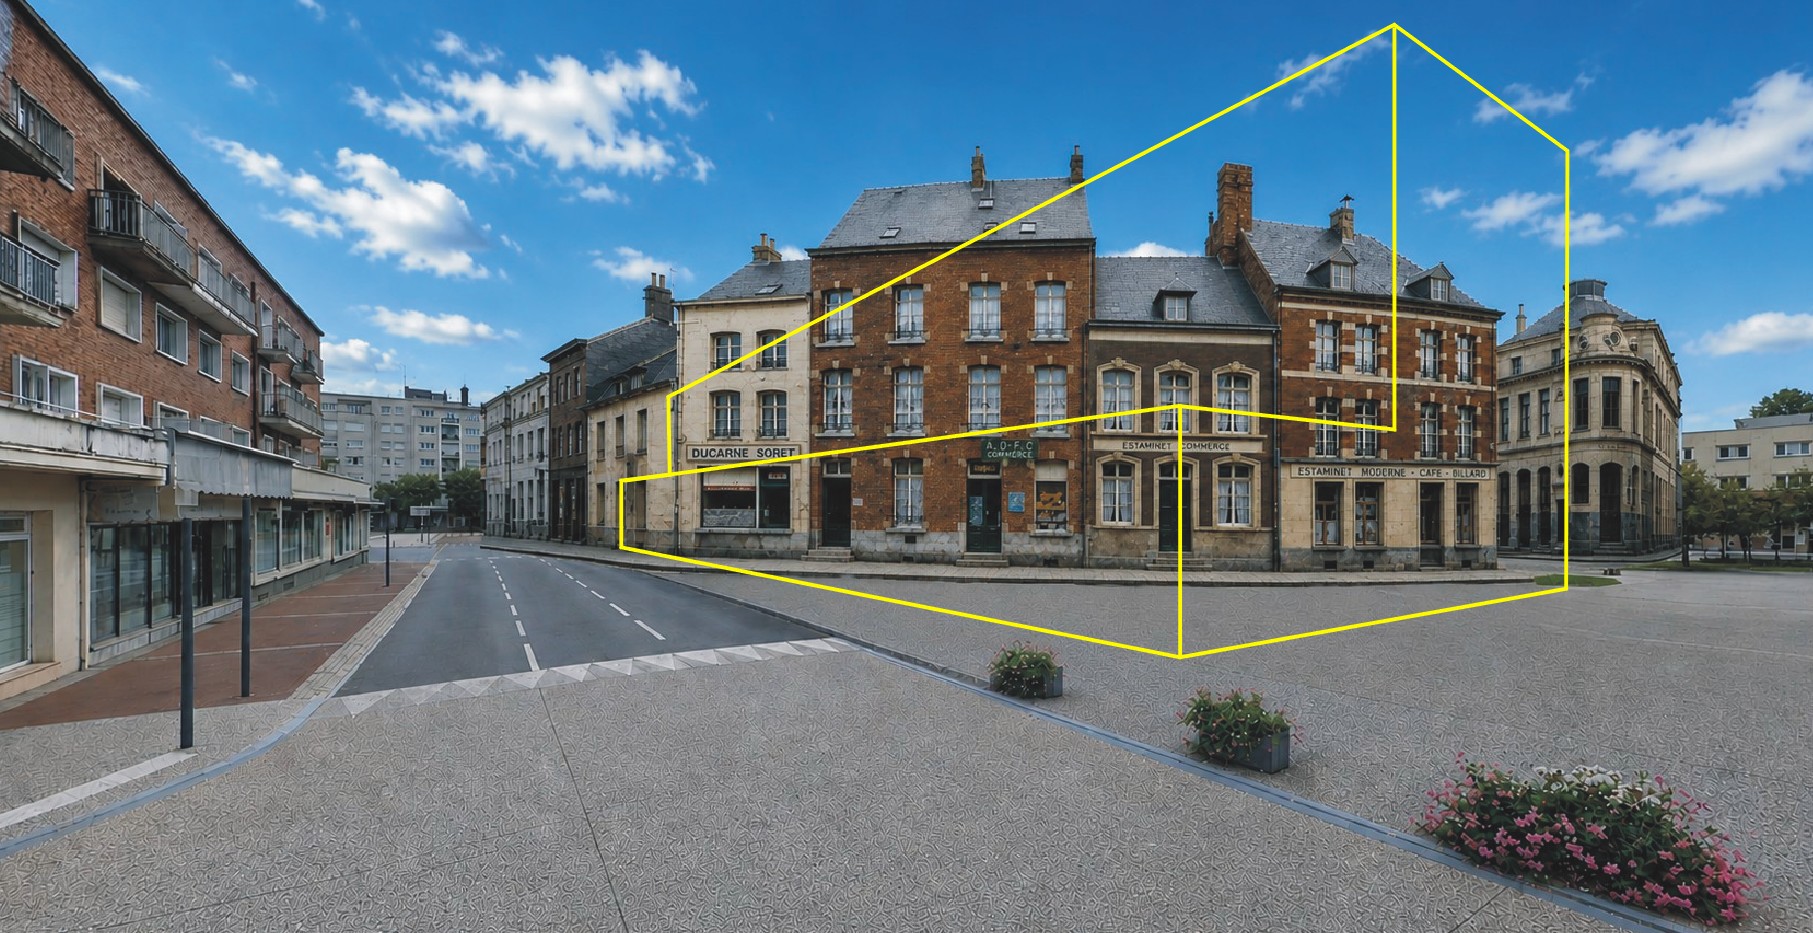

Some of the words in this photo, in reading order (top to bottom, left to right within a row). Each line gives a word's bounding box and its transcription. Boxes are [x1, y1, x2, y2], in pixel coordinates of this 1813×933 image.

[691, 447, 748, 458] DUCARNE
[757, 447, 795, 458] SORET
[1298, 466, 1352, 476] ESTAMINET
[1420, 468, 1442, 478] CAFE
